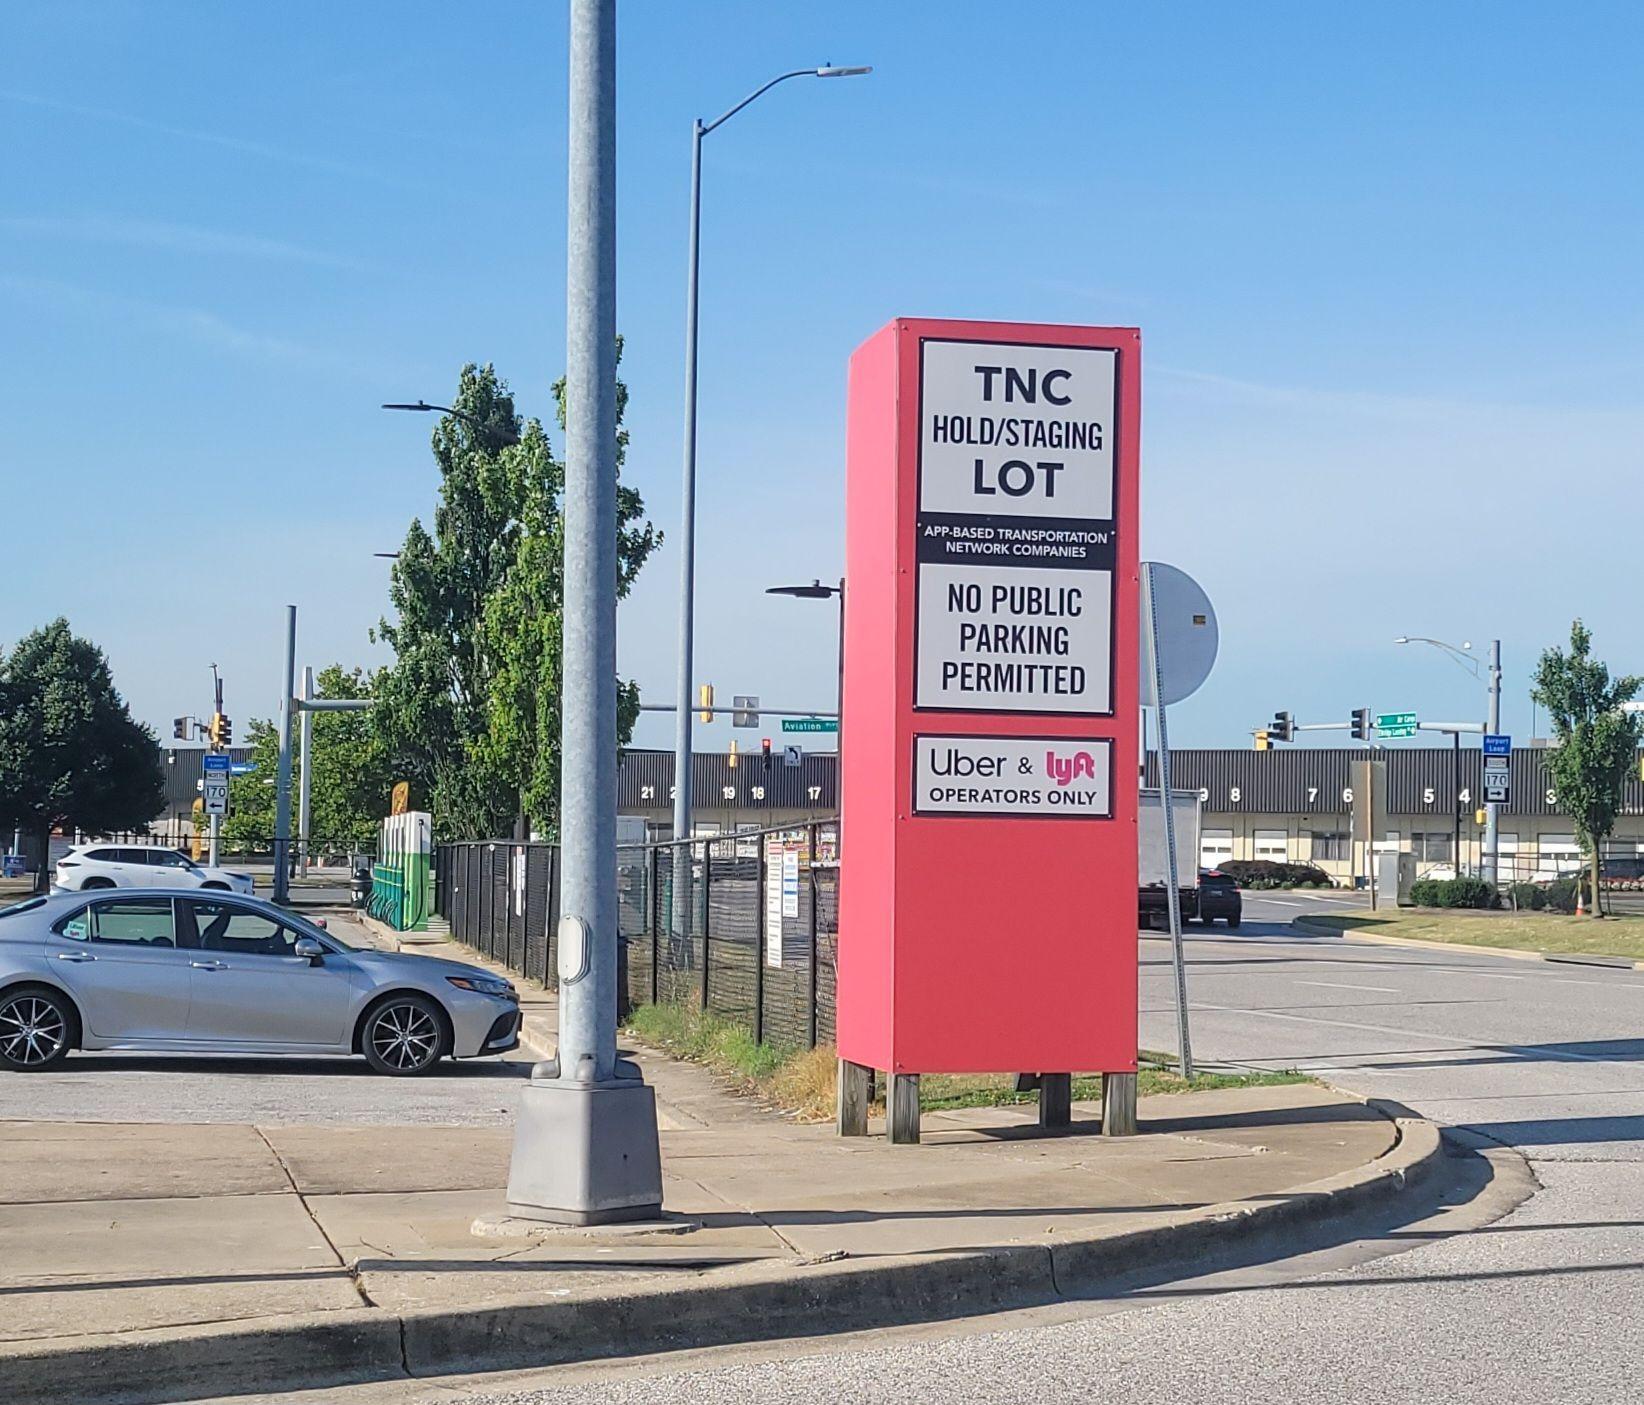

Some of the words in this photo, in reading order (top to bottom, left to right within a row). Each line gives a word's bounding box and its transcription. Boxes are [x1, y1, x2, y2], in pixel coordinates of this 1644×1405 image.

[974, 366, 1073, 406] TNC
[933, 414, 1103, 451] HOLD/STAGING
[974, 459, 1064, 498] LOT
[924, 525, 994, 539] APP-BASED
[997, 529, 1108, 544] TRANSPORTATION
[946, 541, 1009, 555] NETWORK
[1013, 544, 1086, 558] COMPANIES
[948, 583, 981, 613] NO
[992, 585, 1082, 617] PUBLIC
[960, 623, 1069, 655] PARKING
[942, 661, 1085, 695] PERMITTED
[784, 722, 822, 731] Aviation
[931, 748, 1007, 777] Uber
[1018, 757, 1033, 774] &
[1046, 751, 1095, 786] lyft
[1487, 775, 1507, 786] 170
[207, 787, 226, 797] 170
[641, 786, 654, 799] 21
[722, 786, 735, 800] 19
[752, 786, 765, 800] 18
[808, 786, 821, 800] 17
[930, 788, 1041, 804] OPERATORS
[1047, 790, 1097, 805] ONLY
[1231, 788, 1240, 802] 8
[1308, 788, 1318, 802] 7
[1343, 788, 1353, 802] 6
[1423, 788, 1434, 803] 5
[1459, 788, 1471, 804] 4
[1545, 789, 1557, 805] 3
